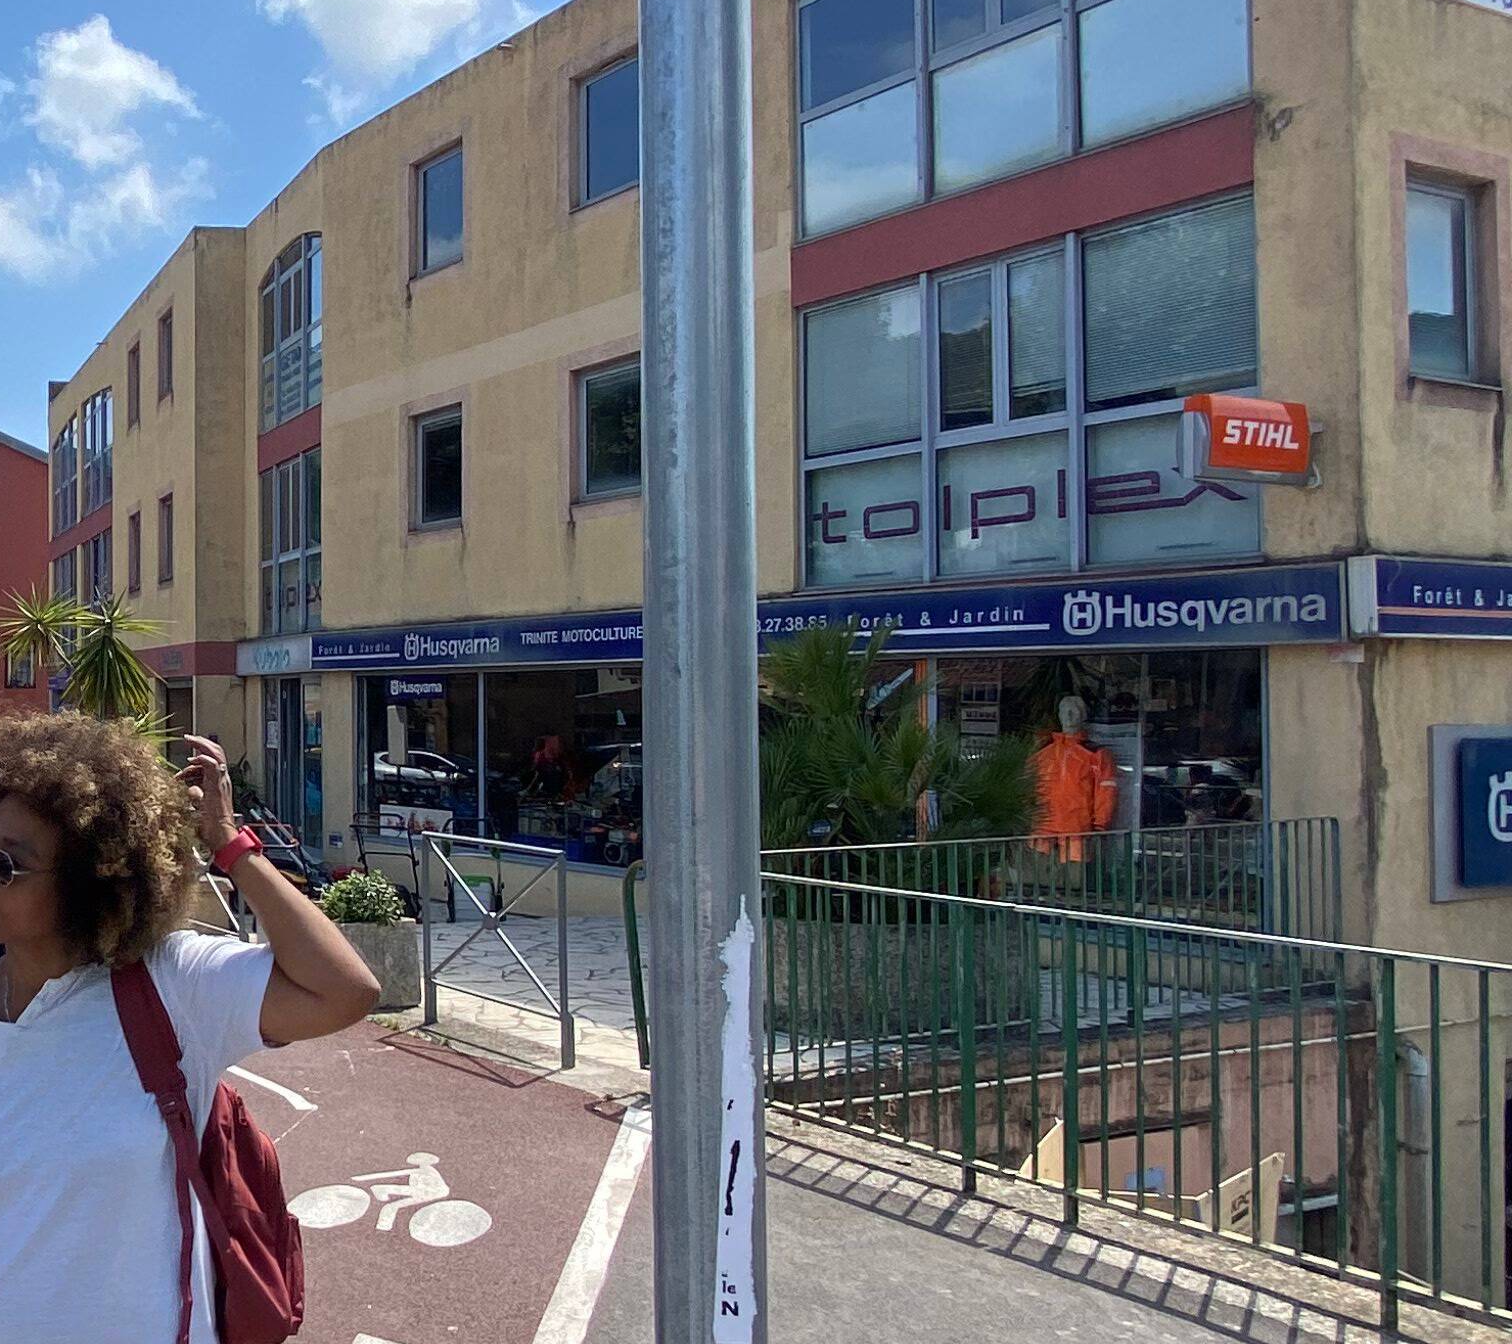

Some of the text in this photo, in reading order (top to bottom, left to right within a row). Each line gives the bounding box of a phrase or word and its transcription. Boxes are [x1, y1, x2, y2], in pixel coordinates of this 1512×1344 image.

[1222, 418, 1300, 451] STIHL
[1413, 586, 1462, 605] Forêt
[1474, 589, 1484, 606] &
[920, 611, 931, 626] &
[949, 606, 1024, 625] Jardin
[1105, 594, 1327, 632] Husqvarna
[520, 626, 643, 645] TRINITE MOTOCULTURE
[420, 635, 500, 659] Husqvarna
[399, 680, 443, 695] Husqvarna
